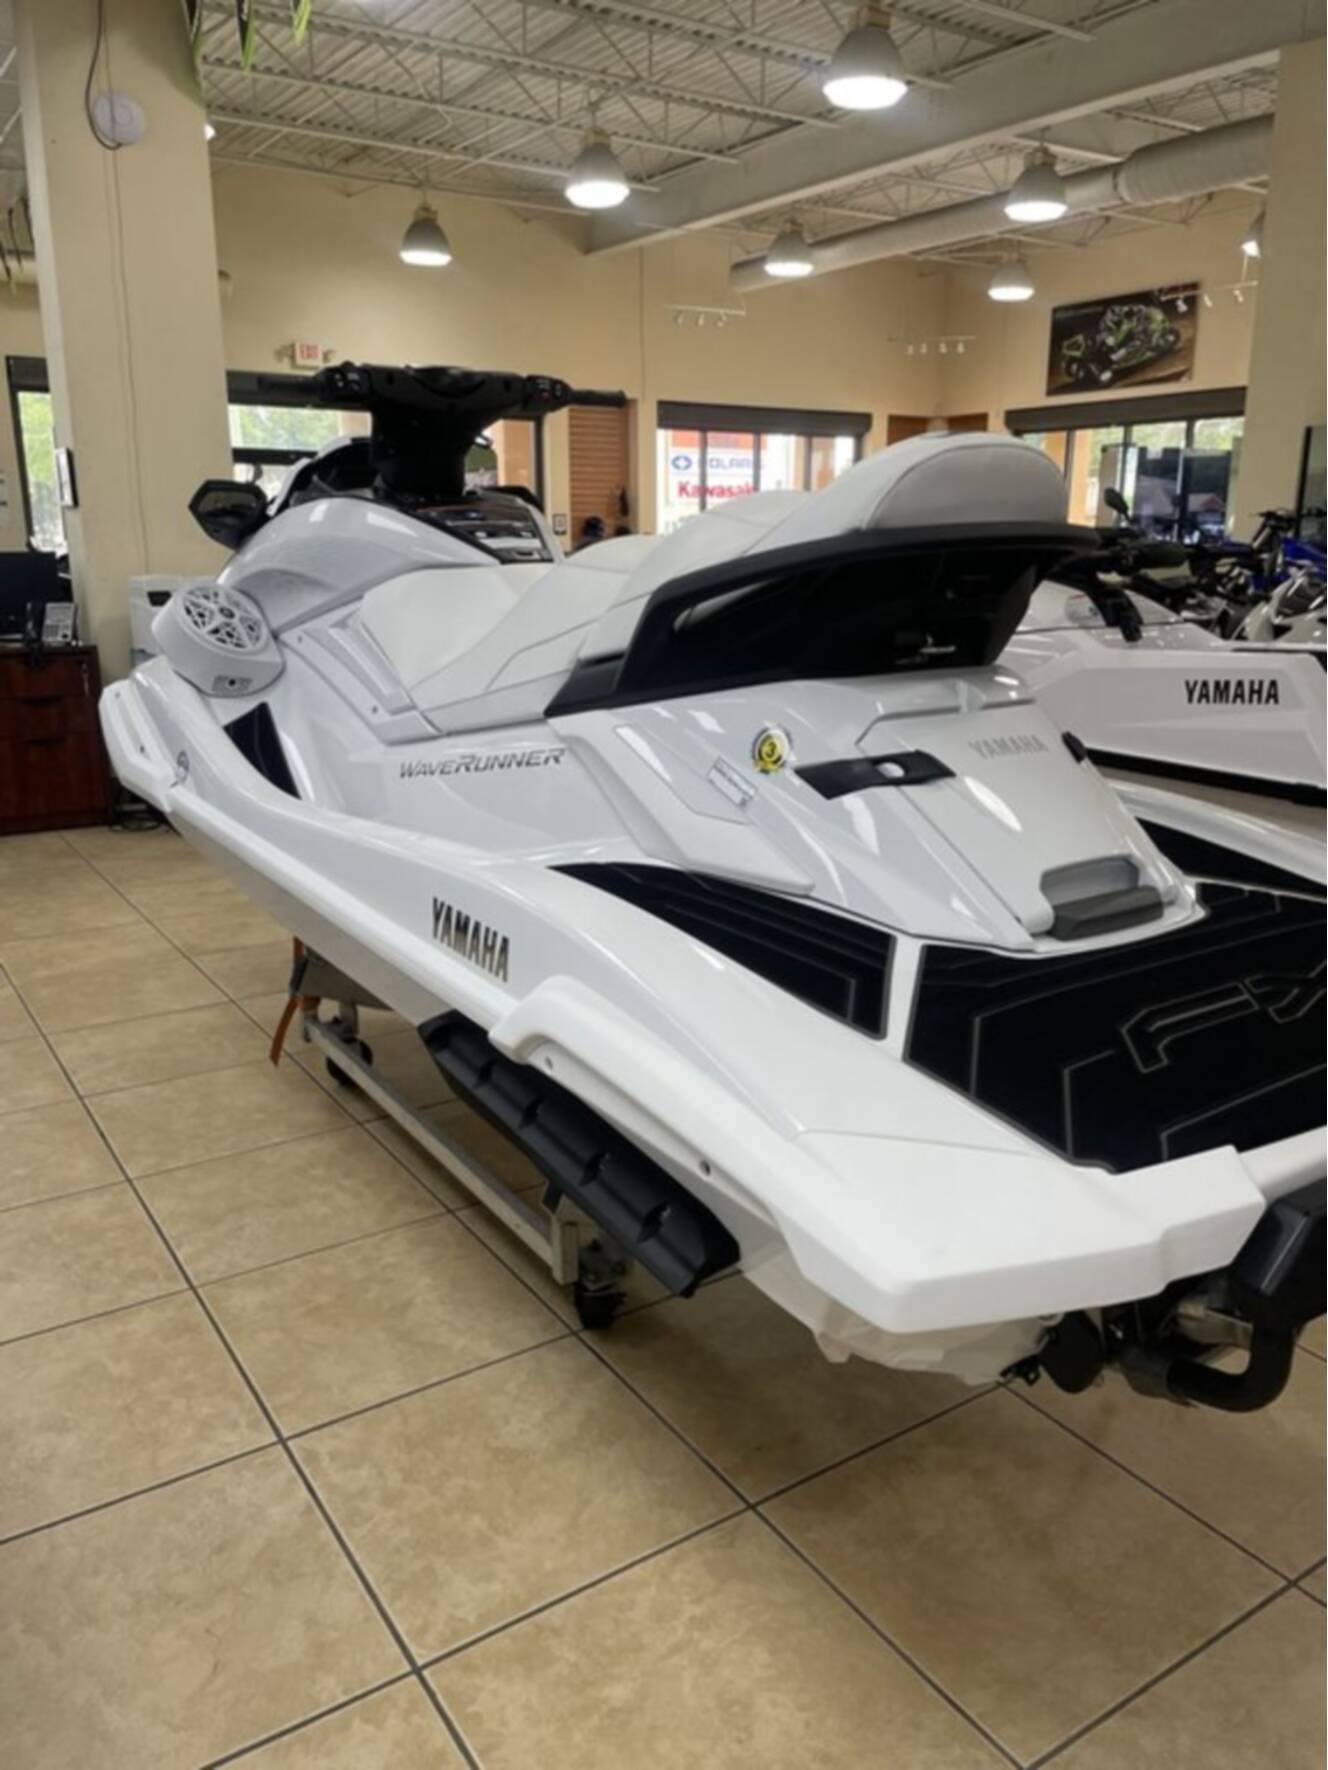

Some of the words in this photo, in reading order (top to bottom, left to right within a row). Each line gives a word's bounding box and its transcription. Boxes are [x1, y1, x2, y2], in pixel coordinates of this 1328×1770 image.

[1184, 678, 1280, 705] YAMAHA
[968, 734, 1050, 760] YAMAHA
[432, 897, 511, 983] YAMAHA
